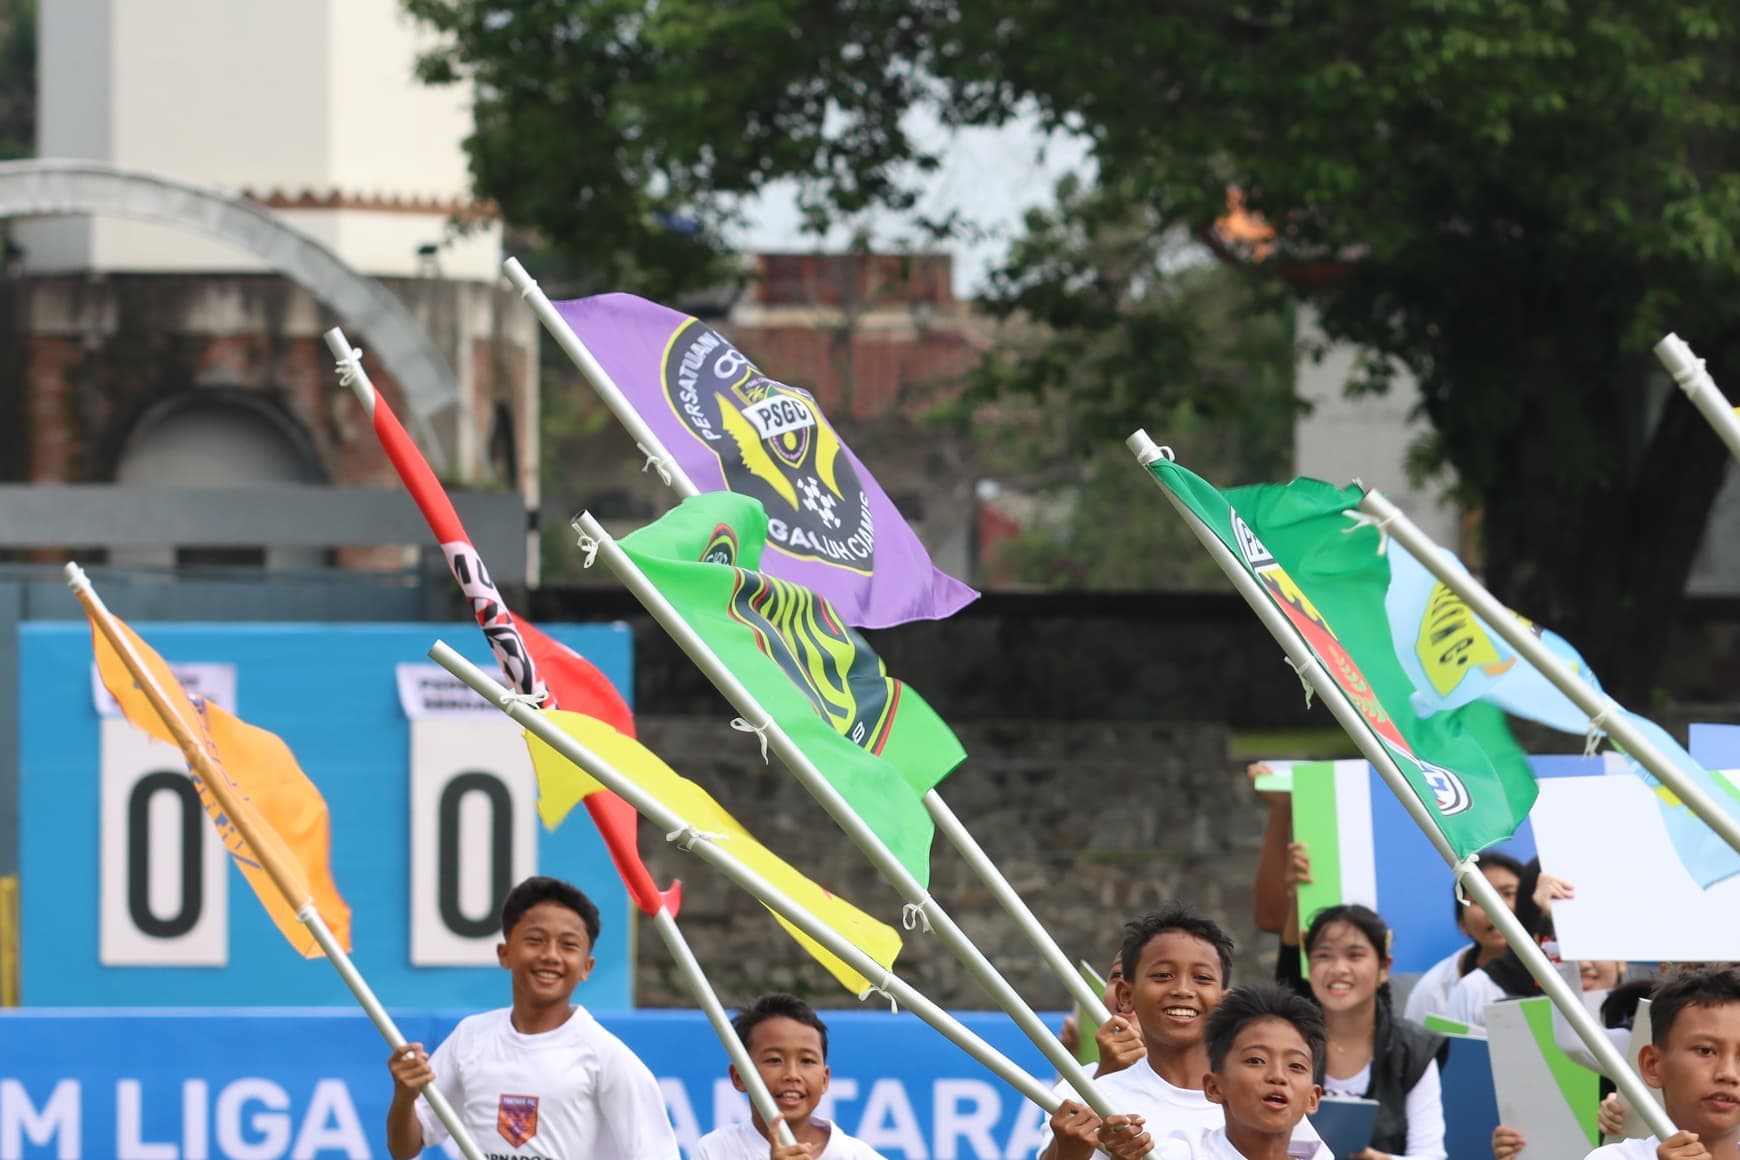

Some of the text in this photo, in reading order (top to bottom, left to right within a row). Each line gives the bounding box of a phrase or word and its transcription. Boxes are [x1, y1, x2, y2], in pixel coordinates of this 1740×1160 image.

[678, 329, 722, 441] PERSATUAN
[767, 517, 855, 561] GALUH
[127, 771, 203, 938] 0
[438, 771, 514, 938] 0
